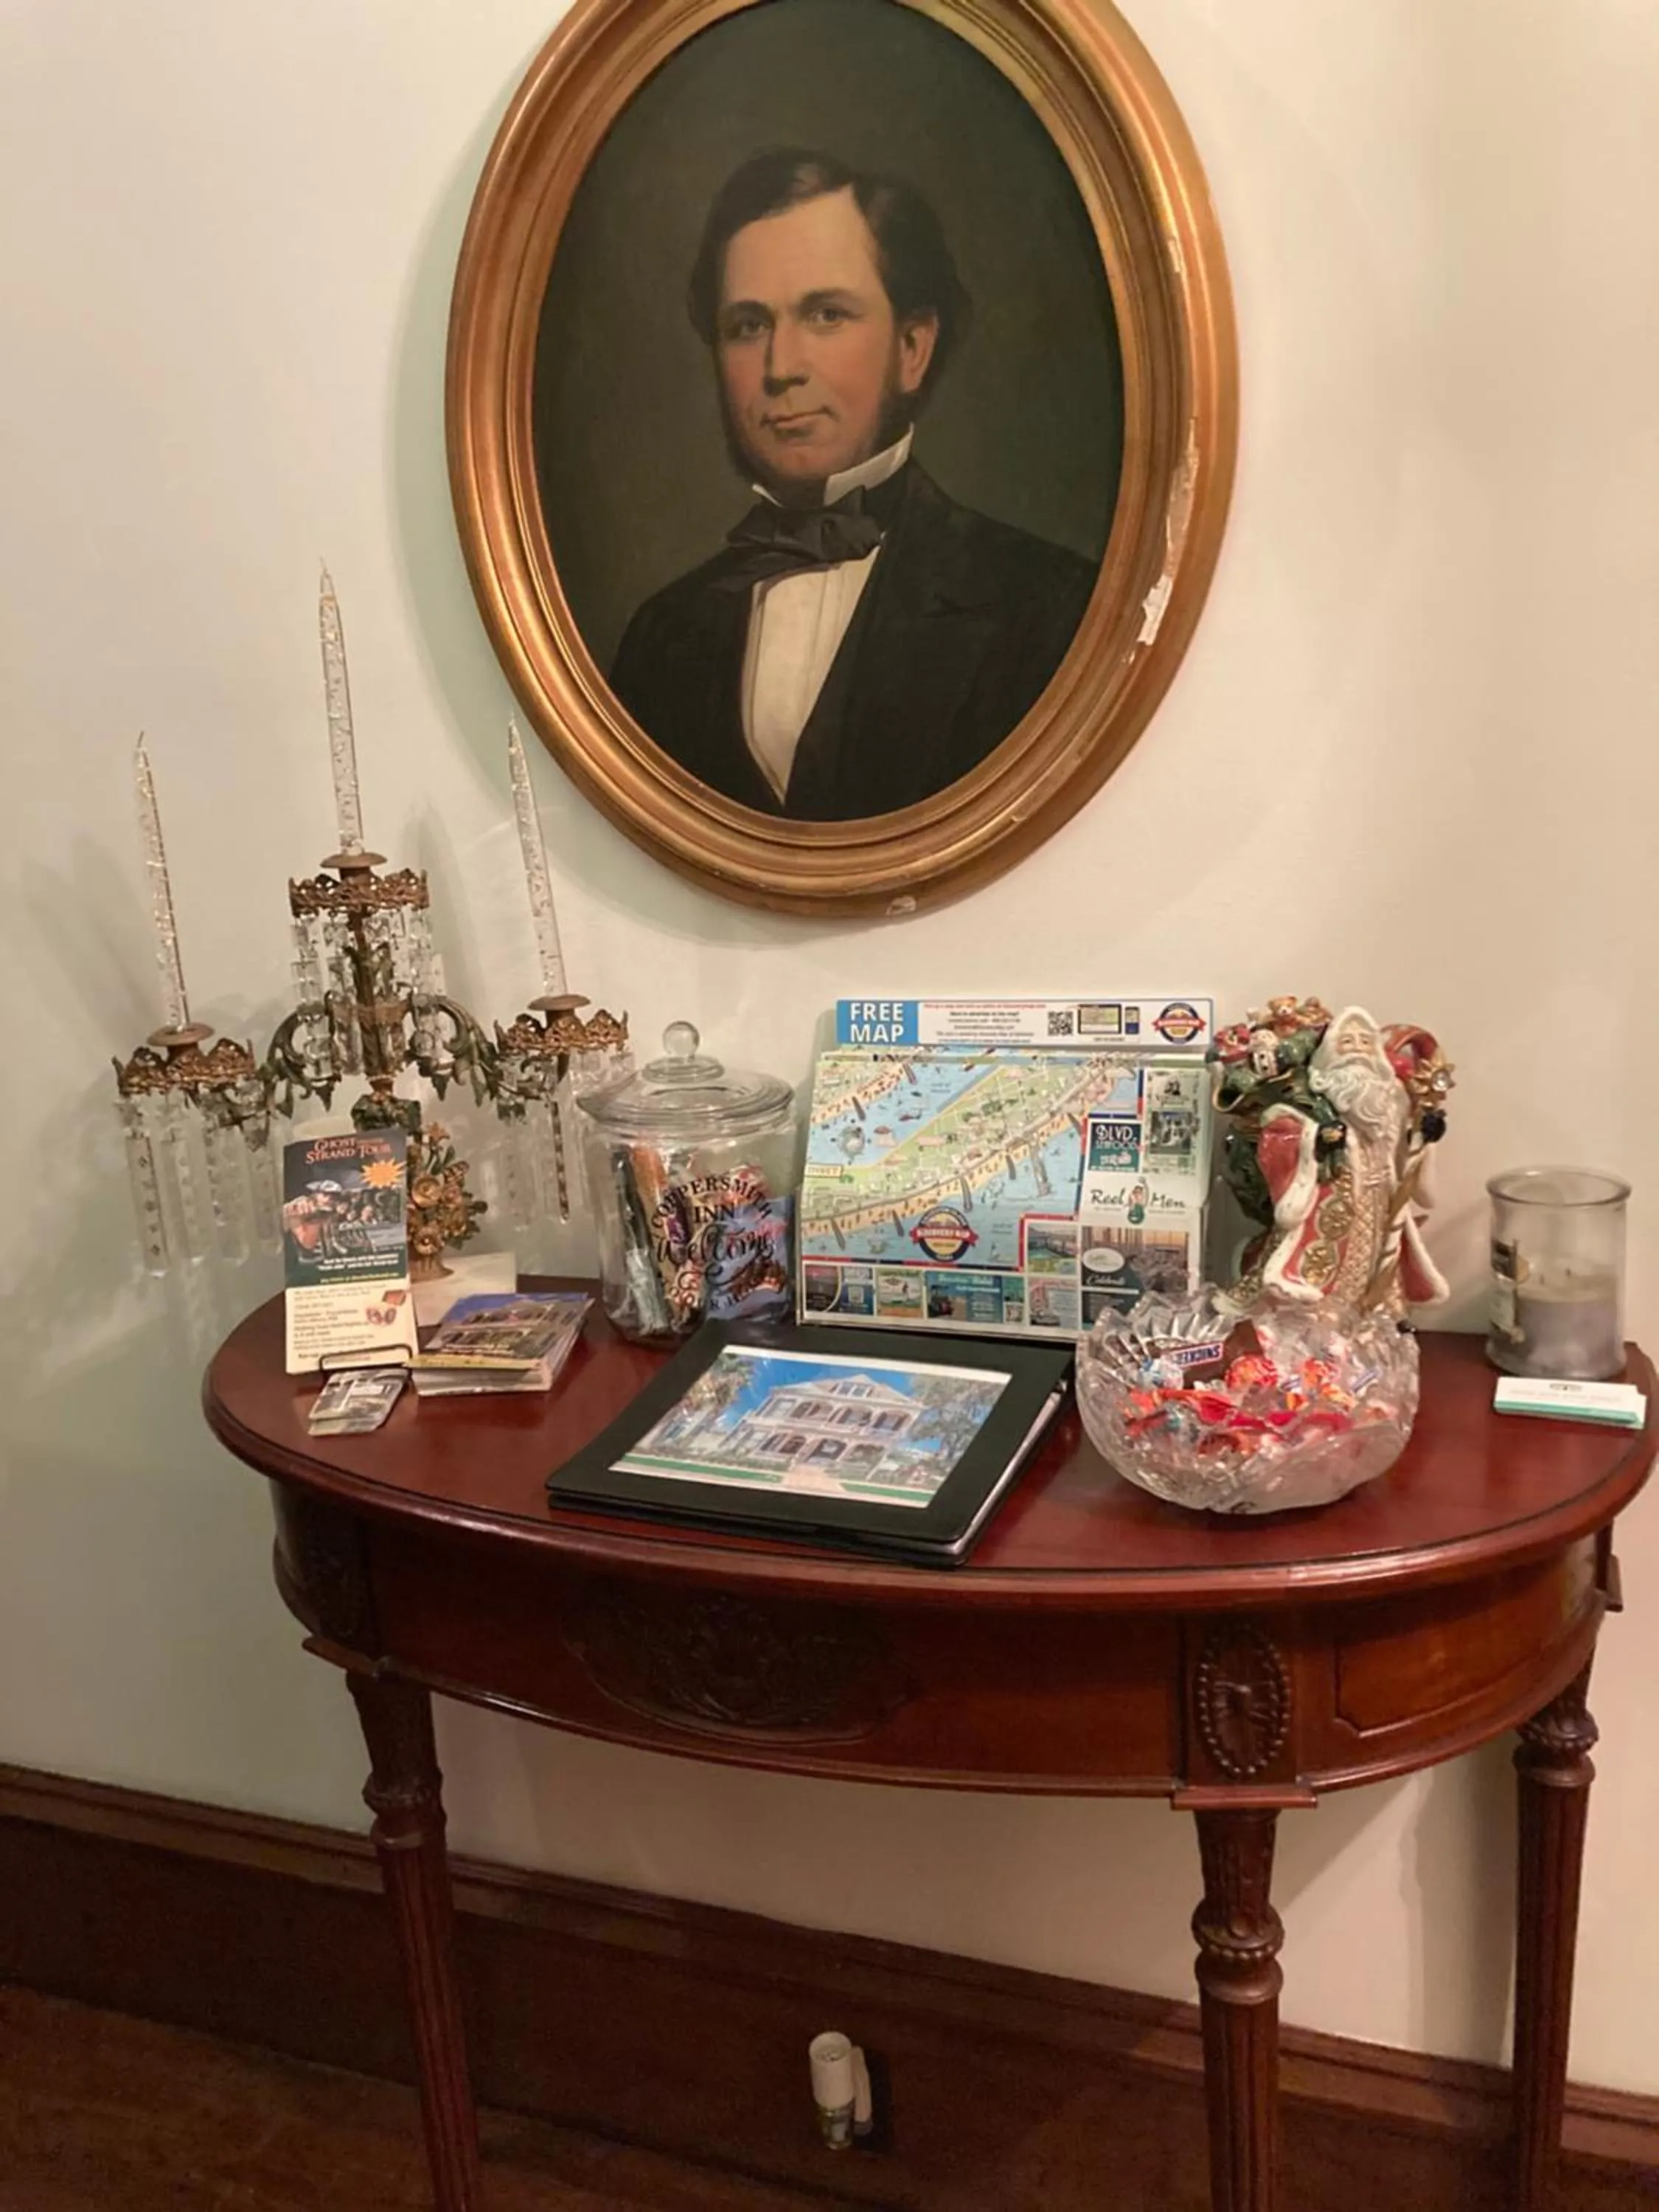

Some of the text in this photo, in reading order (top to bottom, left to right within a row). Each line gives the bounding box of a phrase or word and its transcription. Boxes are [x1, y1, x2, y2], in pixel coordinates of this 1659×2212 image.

[850, 1002, 904, 1021] FREE
[850, 1023, 904, 1043] MAP
[694, 1201, 736, 1224] INN
